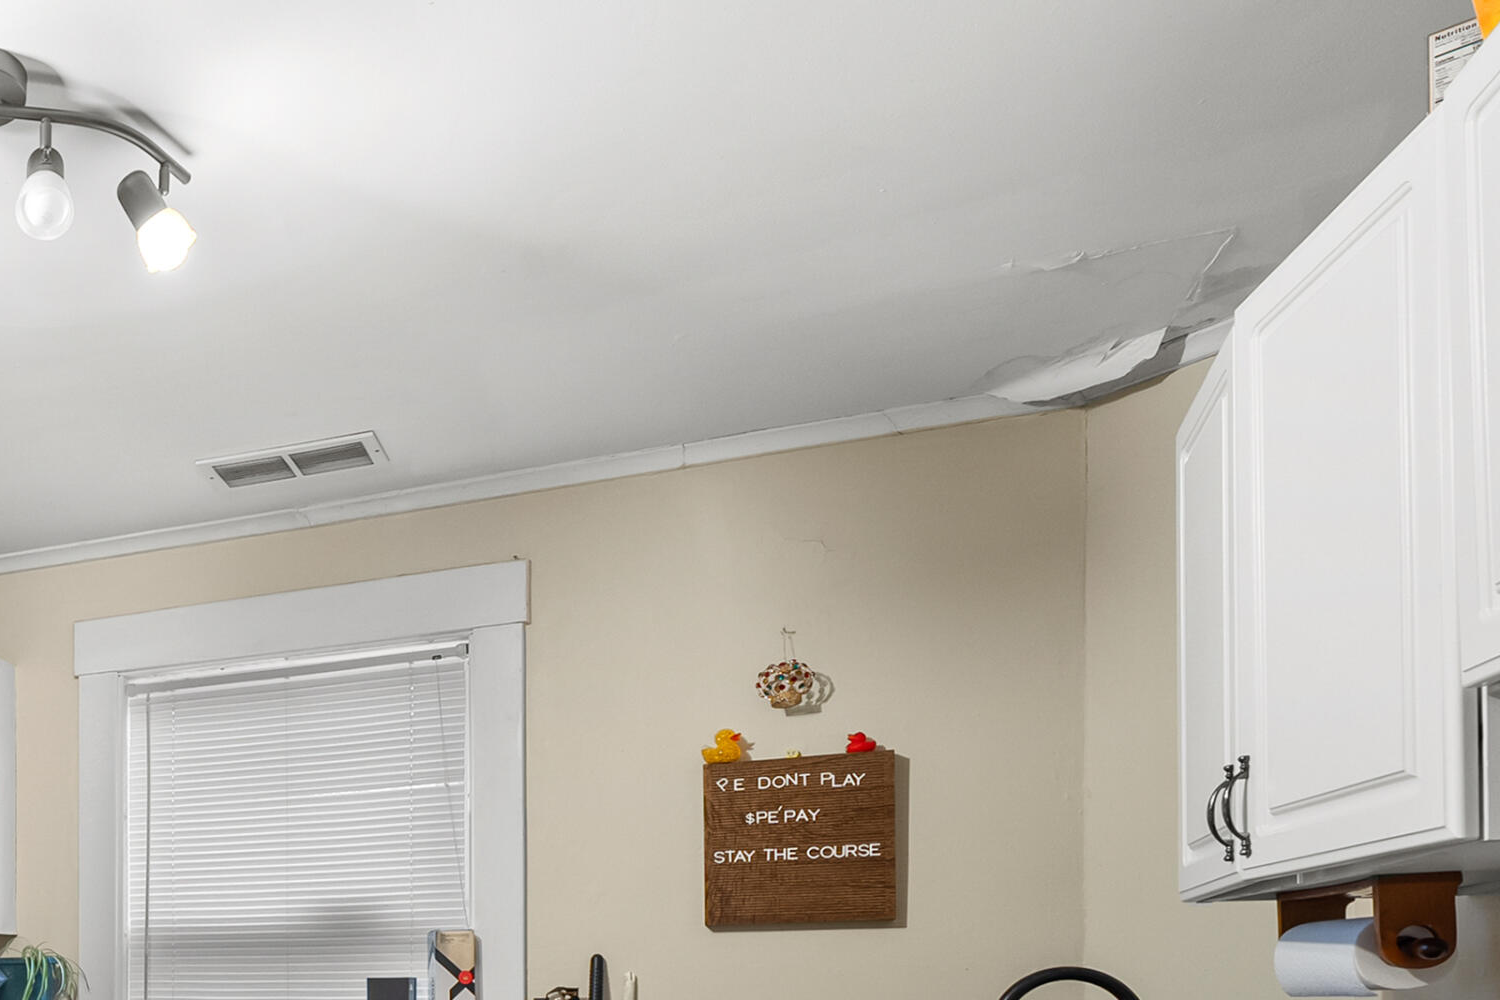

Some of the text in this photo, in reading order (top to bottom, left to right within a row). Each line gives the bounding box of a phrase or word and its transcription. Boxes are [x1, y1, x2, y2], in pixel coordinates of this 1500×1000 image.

[1434, 22, 1478, 42] Nutrition
[757, 772, 811, 790] DONT
[820, 772, 866, 788] PLAY
[713, 843, 882, 864] STAY THE COURSE
